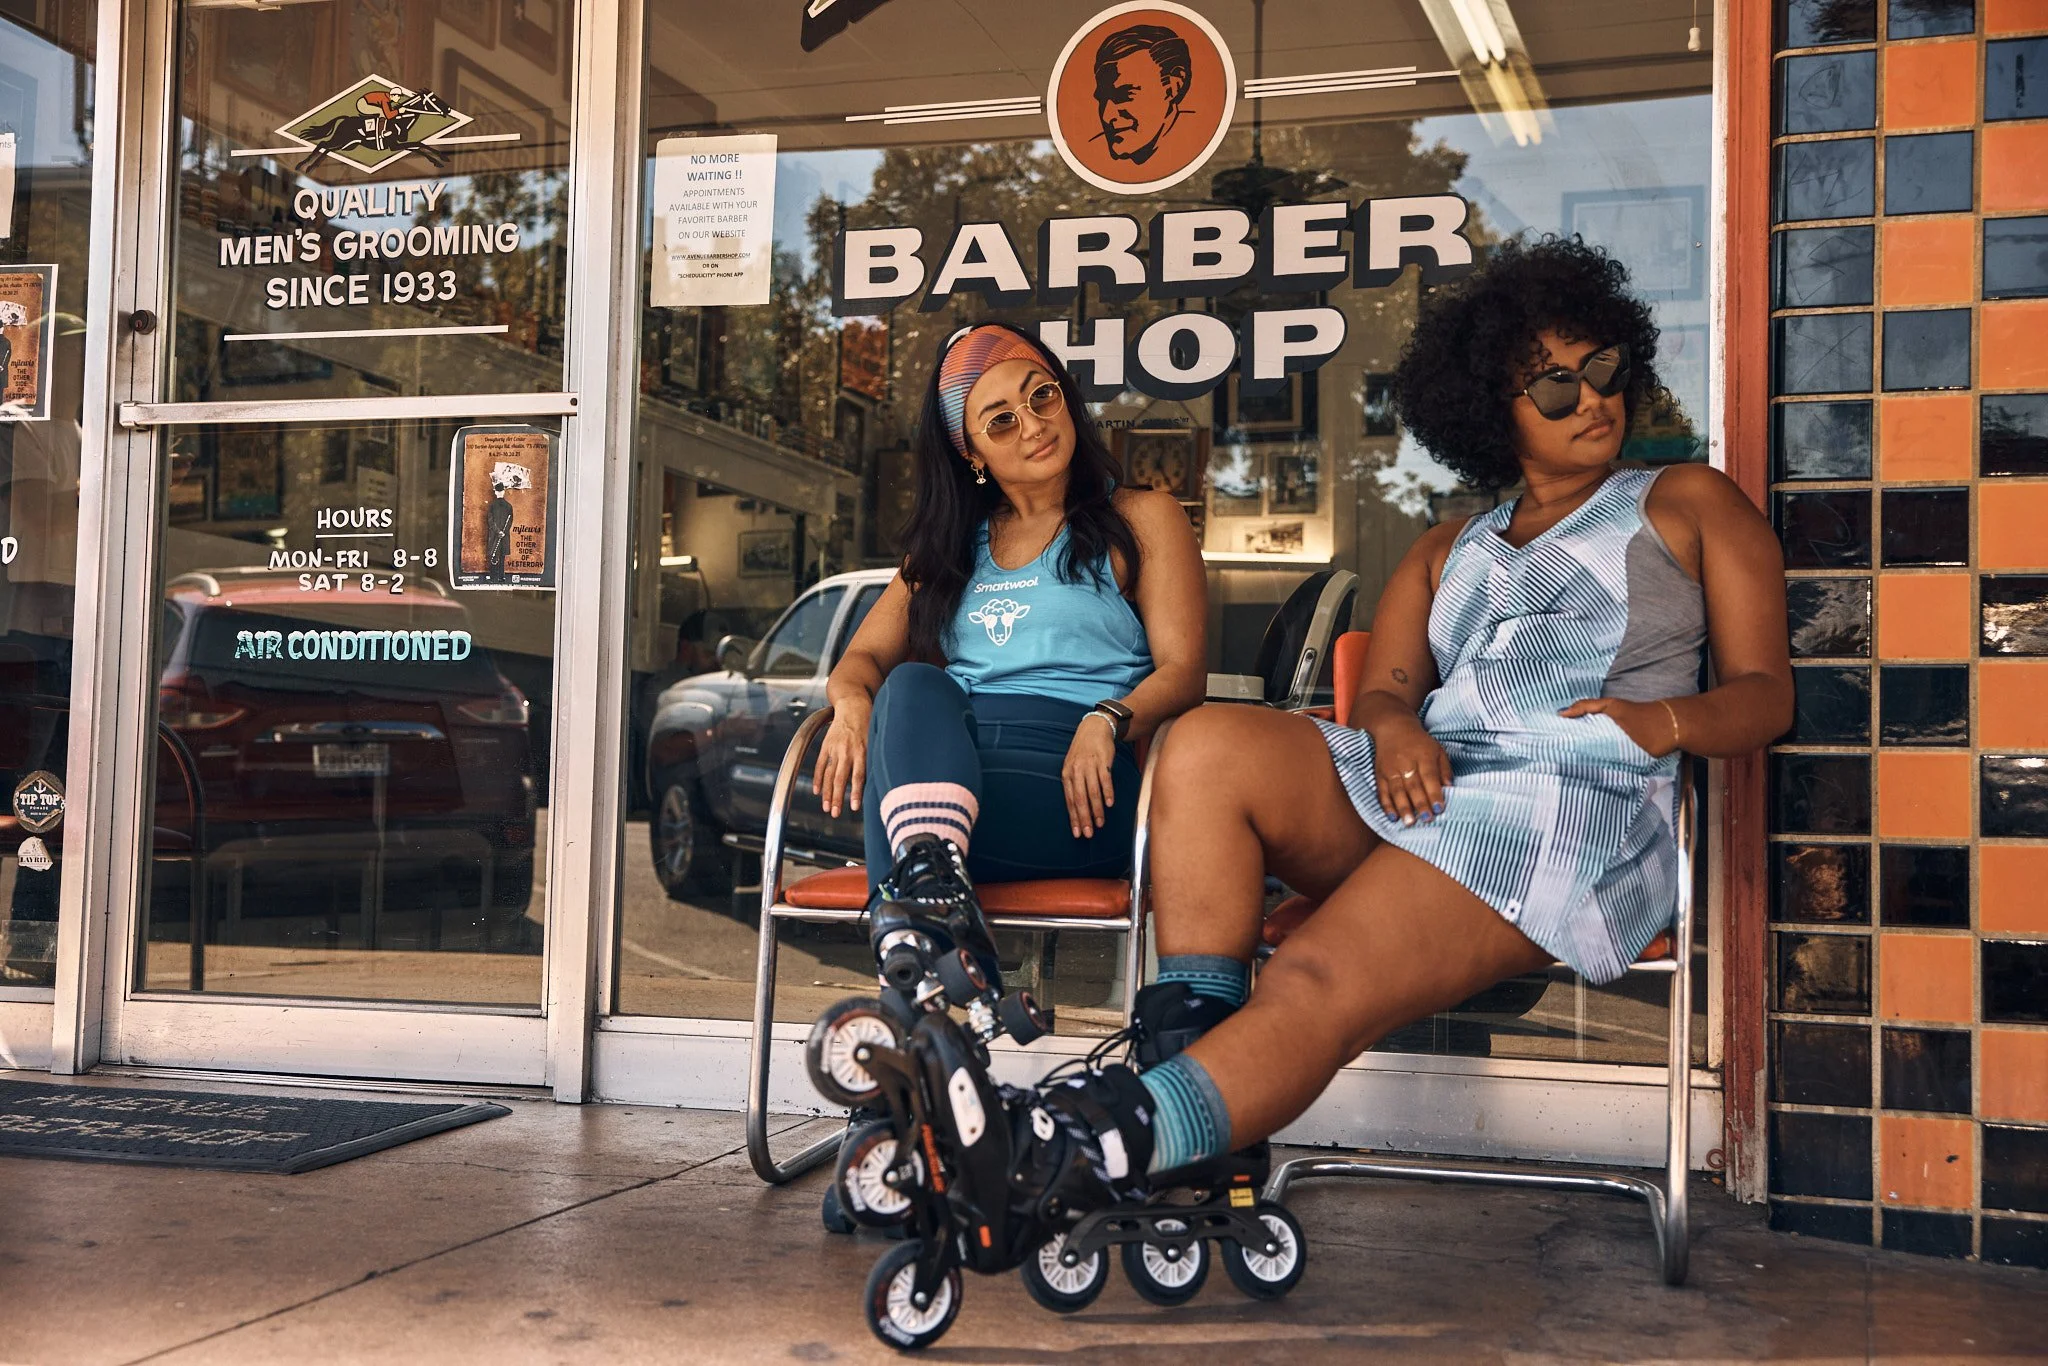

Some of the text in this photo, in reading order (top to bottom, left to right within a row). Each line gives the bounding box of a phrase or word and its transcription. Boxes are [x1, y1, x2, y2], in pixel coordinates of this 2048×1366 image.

[691, 153, 740, 165] NO MORE
[687, 169, 742, 181] WAITING !!
[293, 182, 446, 220] QUALITY
[683, 188, 745, 198] APPOINTMENTS
[669, 201, 758, 212] AVAILABLE WITH YOUR
[678, 215, 748, 224] FAVORITE BARBER
[678, 230, 746, 239] ON OUR WEBSITE
[220, 222, 521, 266] MEN'S GROOMING
[835, 194, 1475, 310] BARBER
[266, 271, 457, 309] SINCE 1933
[942, 306, 1348, 398] HOP
[317, 507, 393, 530] HOURS
[515, 541, 537, 549] OTHER
[268, 548, 438, 570] MON-FRI 8-8
[507, 560, 544, 568] YESTERDAY
[299, 573, 404, 593] SAT 8-2
[974, 576, 1039, 593] Smartwool
[235, 631, 471, 661] AIR CONDITIONED
[20, 793, 60, 806] TIP TOP
